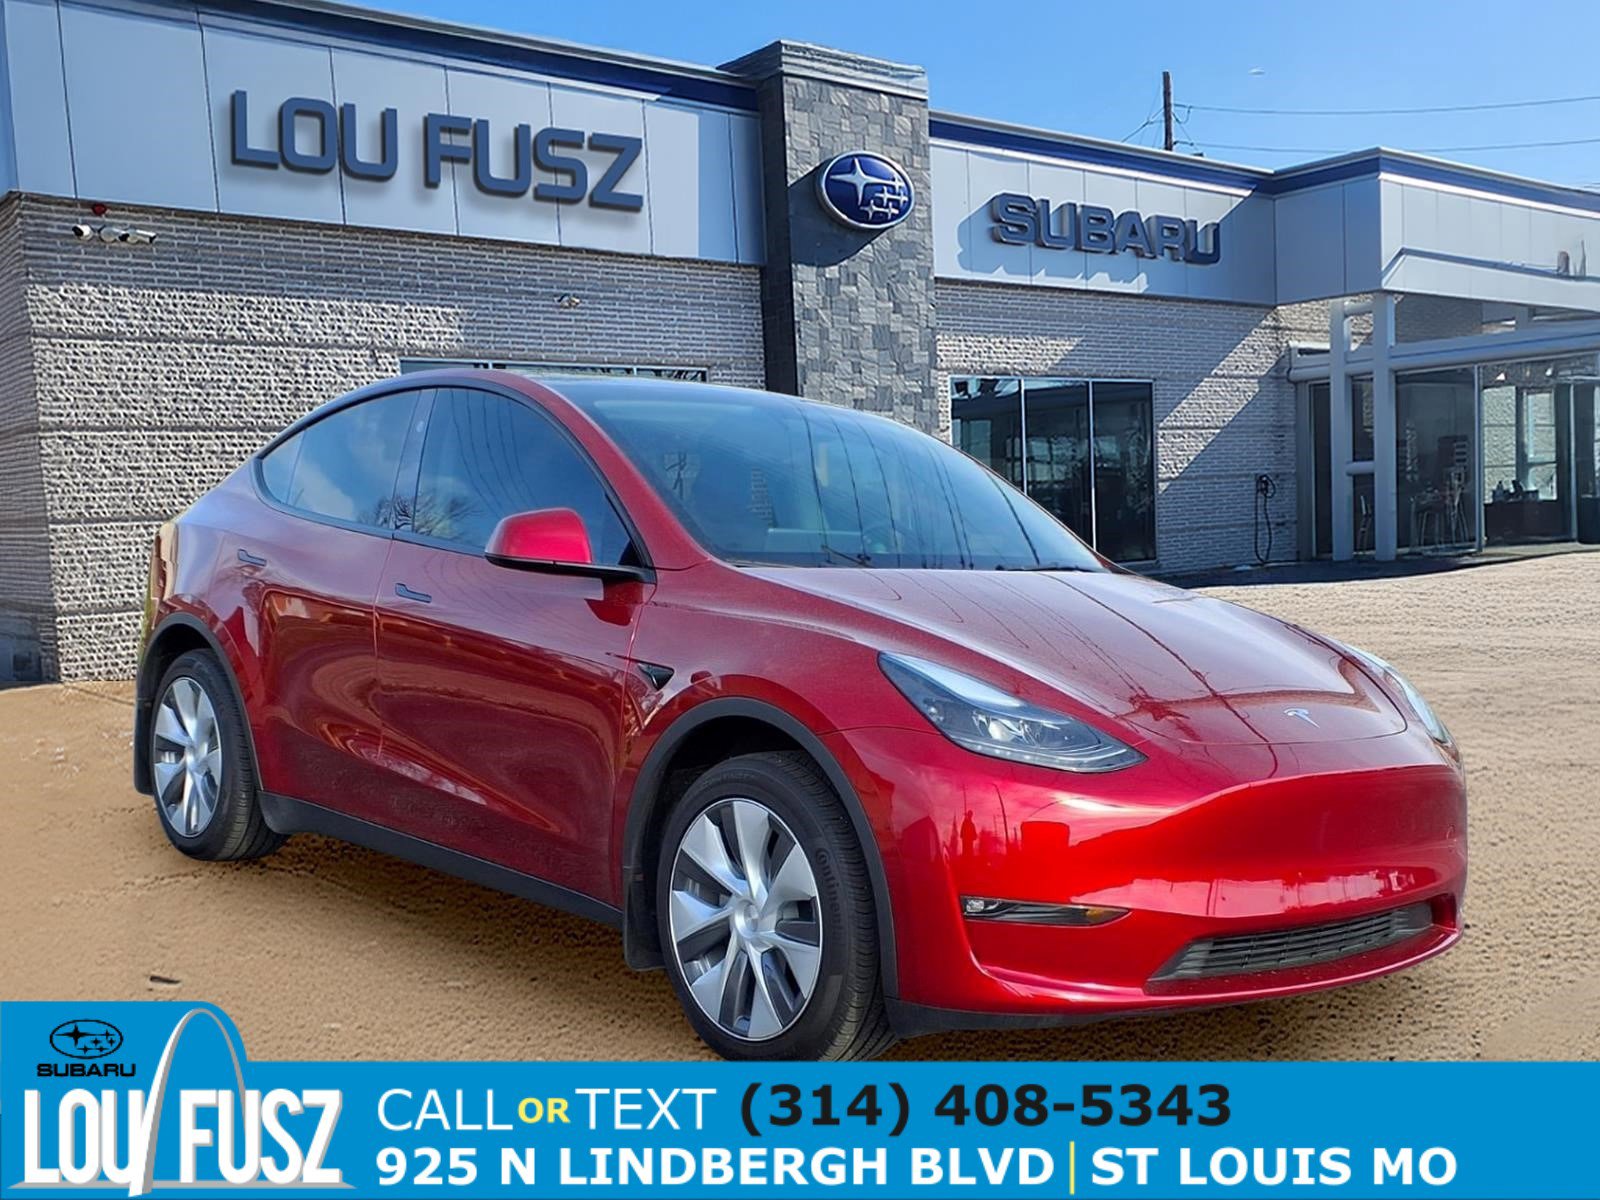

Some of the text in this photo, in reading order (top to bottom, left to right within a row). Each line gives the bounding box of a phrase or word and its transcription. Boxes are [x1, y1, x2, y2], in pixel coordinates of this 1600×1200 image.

[231, 90, 644, 210] LOU FUSZ
[991, 192, 1221, 265] SUBARU
[815, 847, 845, 945] Continenta
